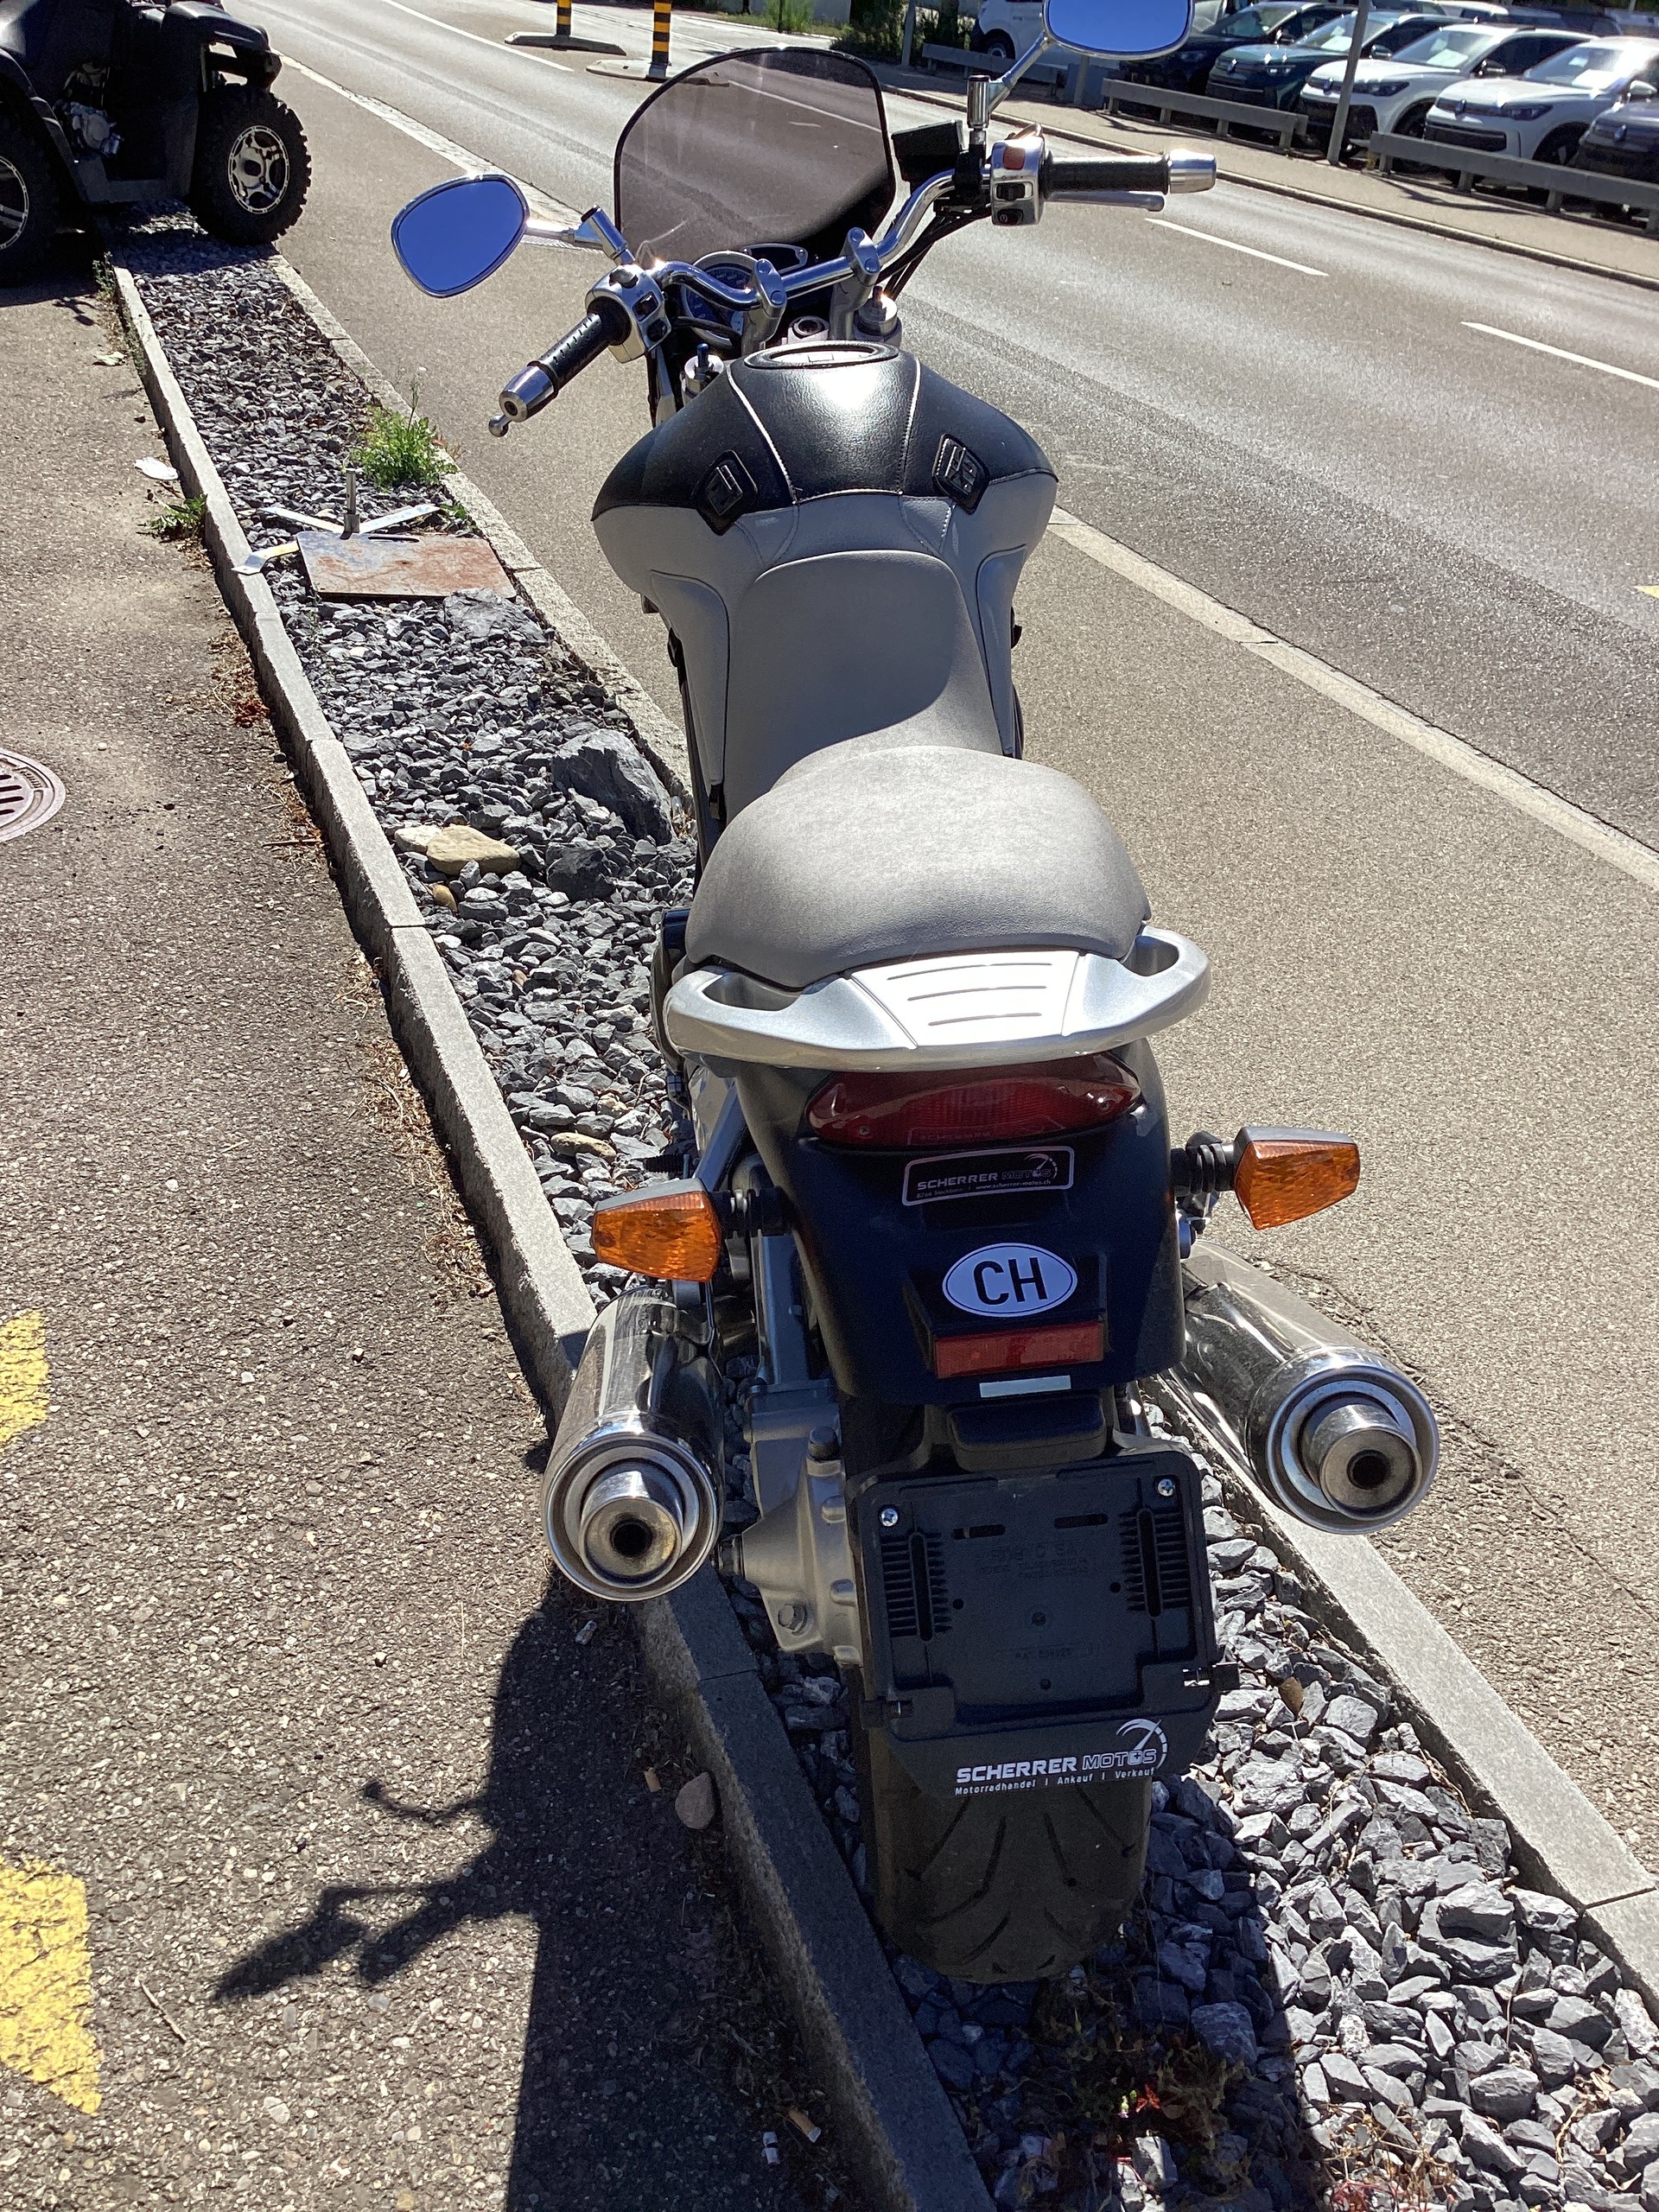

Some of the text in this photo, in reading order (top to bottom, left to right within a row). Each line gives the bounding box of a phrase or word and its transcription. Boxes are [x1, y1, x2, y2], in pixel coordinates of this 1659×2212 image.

[917, 1169, 1052, 1191] SCHERRER MOTOS
[973, 1256, 1048, 1306] CH
[955, 1779, 1036, 1796] Motorradhandel
[1057, 1773, 1093, 1785] Ankauf
[1115, 1766, 1154, 1779] Verkauf
[957, 1748, 1157, 1783] SCHERRER MOTOS
